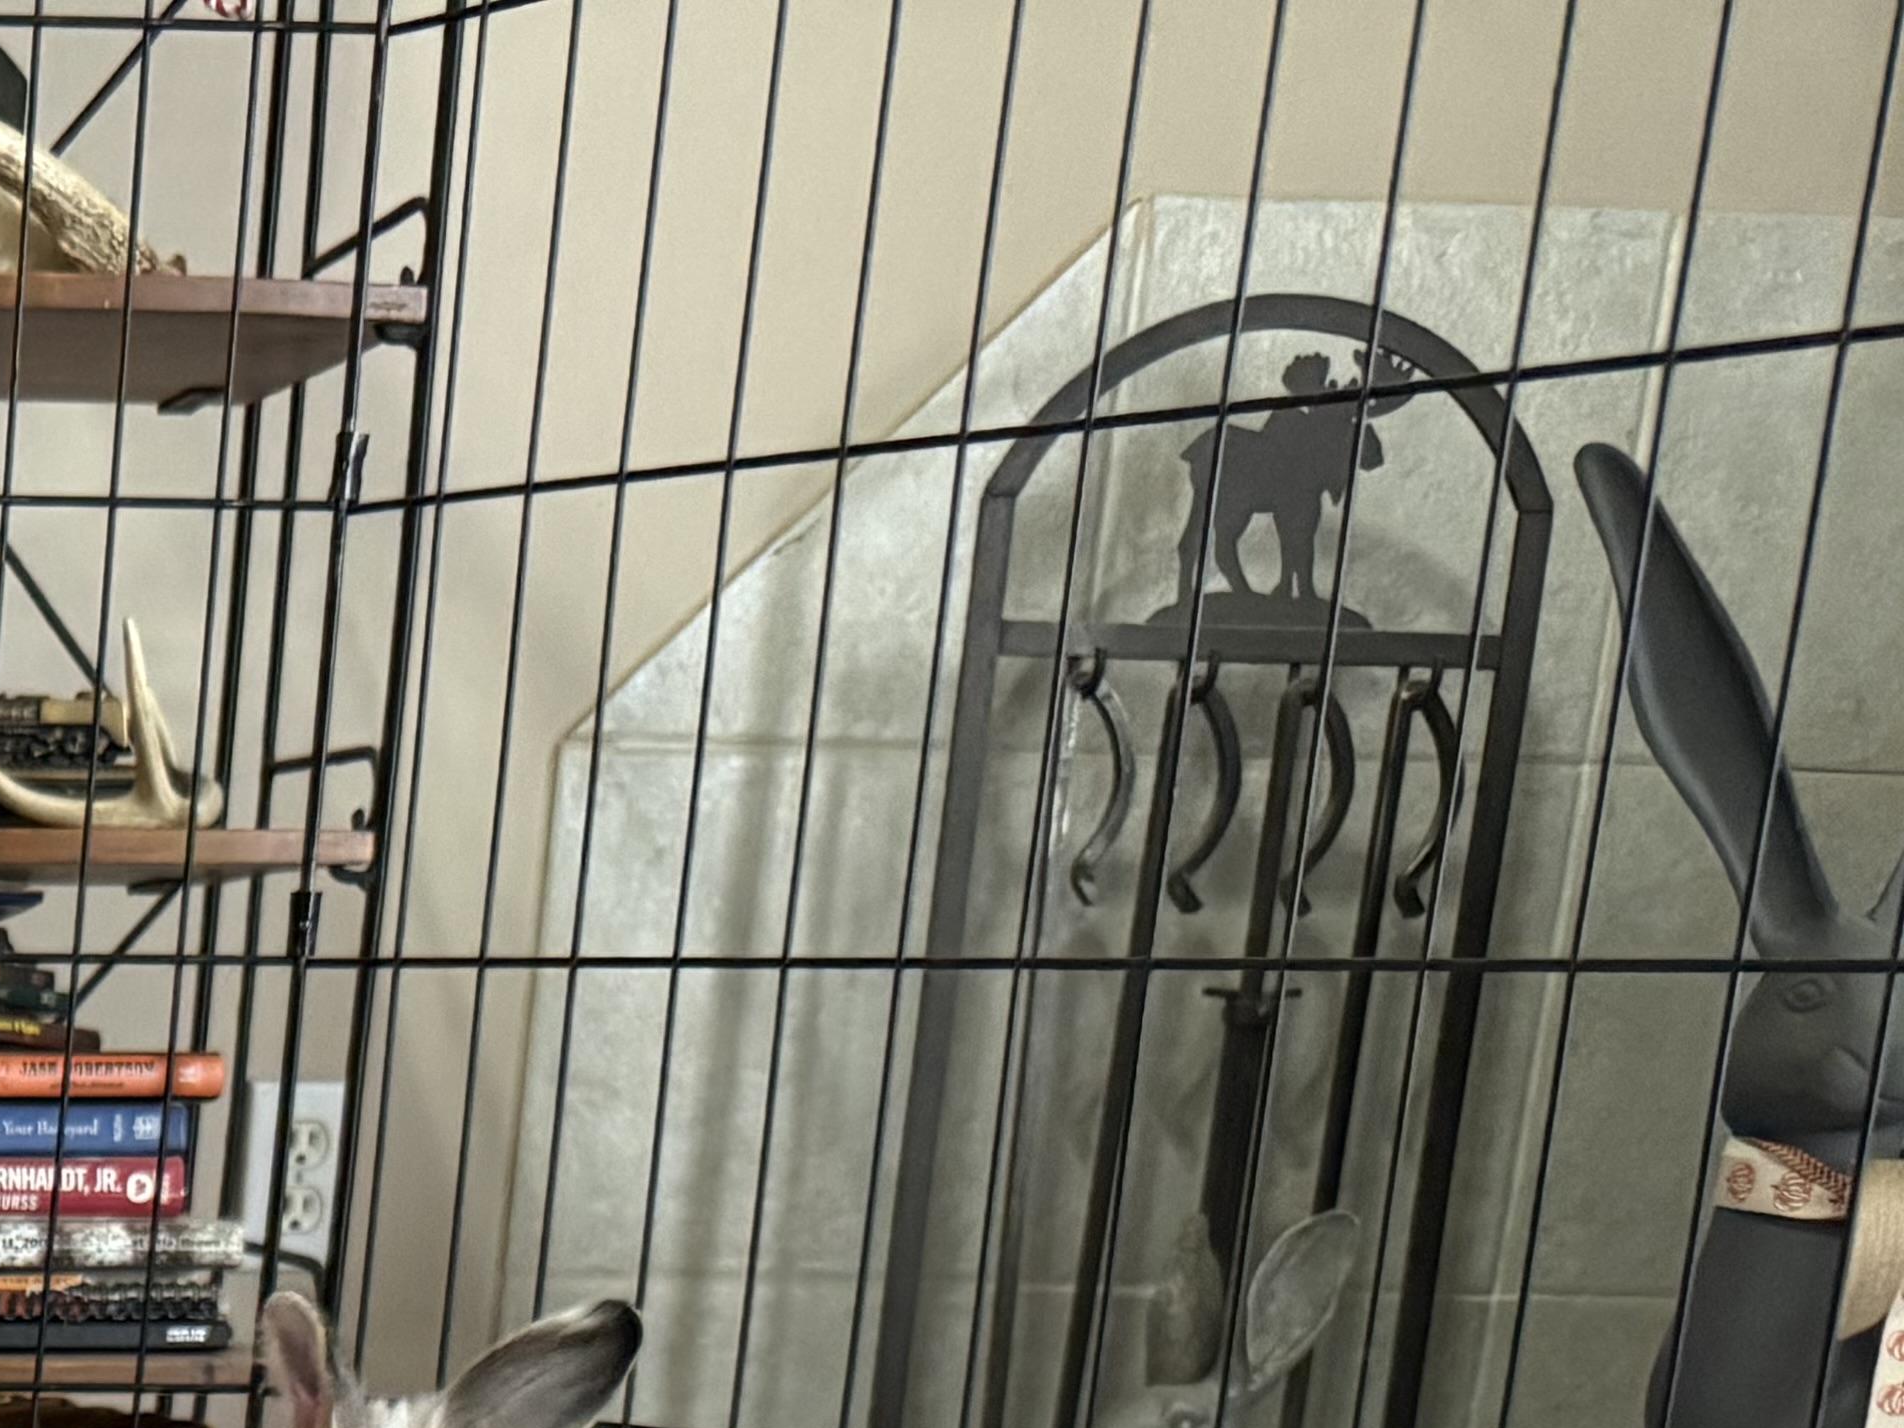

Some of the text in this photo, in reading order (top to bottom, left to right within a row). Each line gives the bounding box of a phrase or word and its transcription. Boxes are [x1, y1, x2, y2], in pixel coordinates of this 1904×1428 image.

[71, 1061, 155, 1077] OBERTSON
[2, 1120, 33, 1136] Your
[37, 1117, 99, 1140] Bacyard
[94, 1168, 122, 1193] JR.
